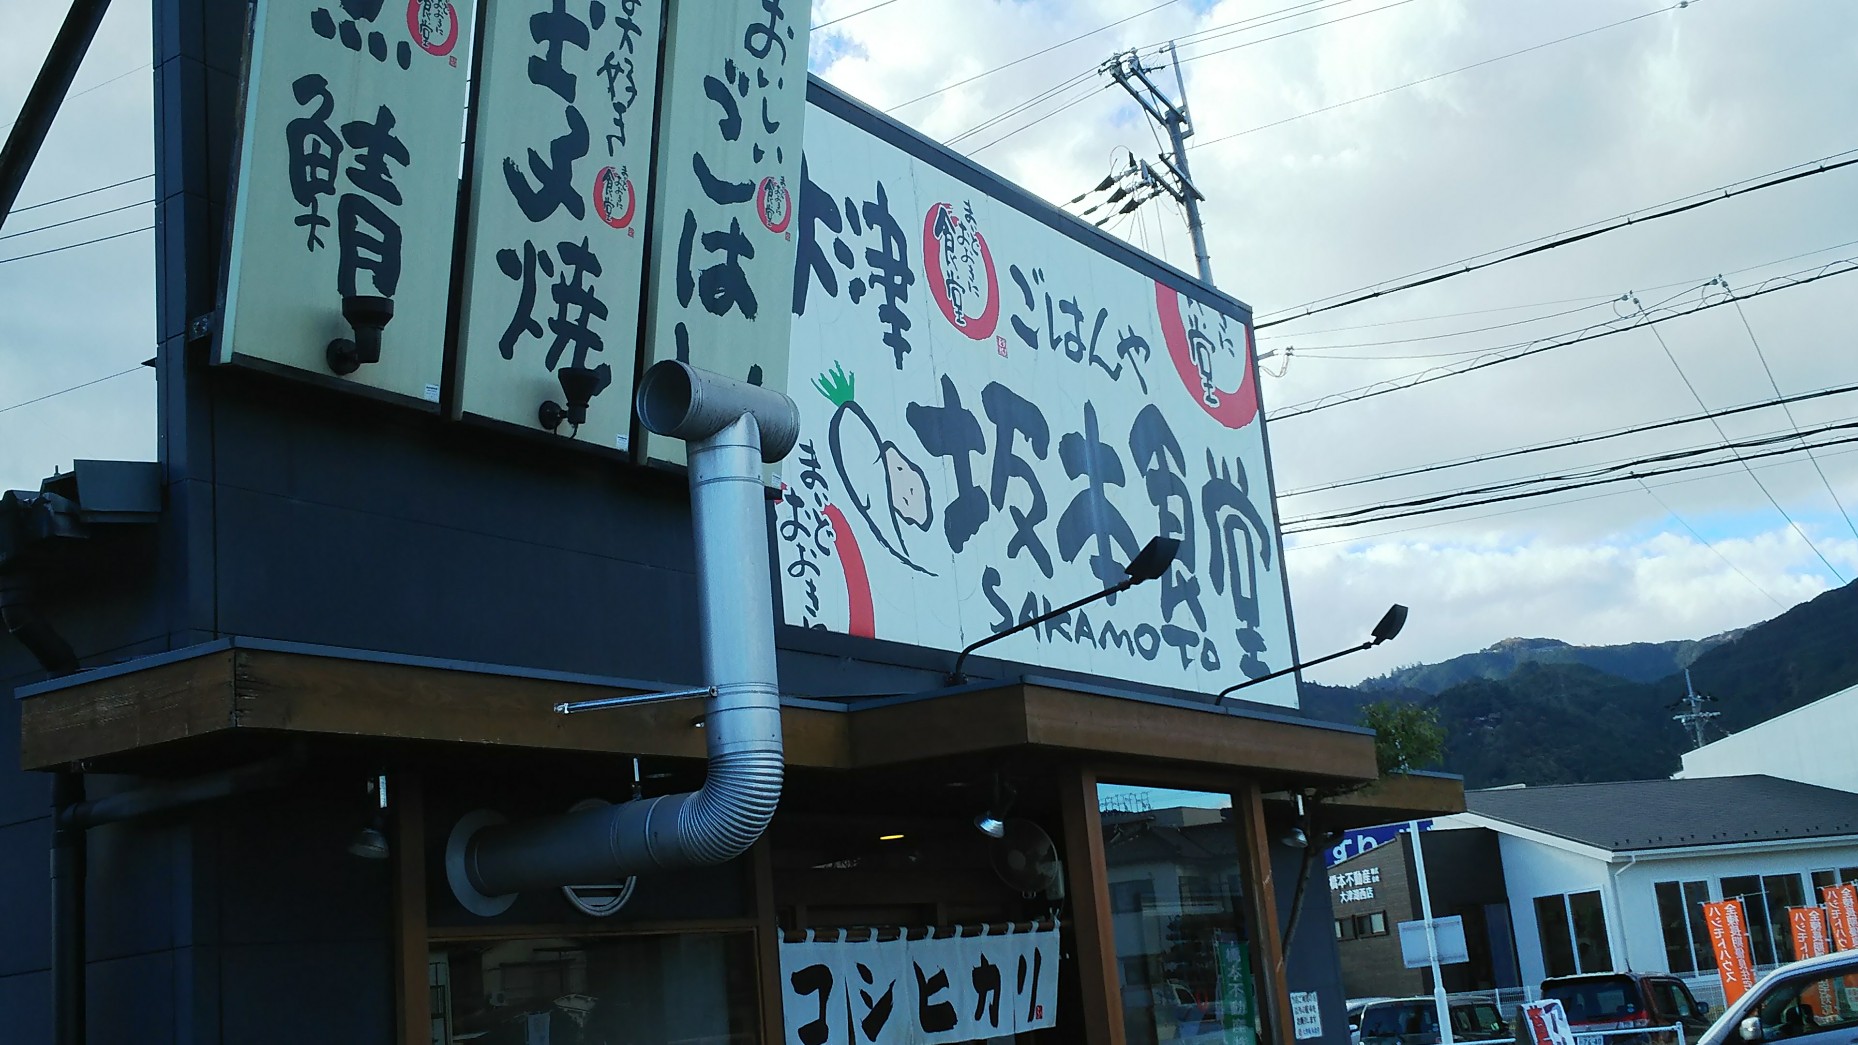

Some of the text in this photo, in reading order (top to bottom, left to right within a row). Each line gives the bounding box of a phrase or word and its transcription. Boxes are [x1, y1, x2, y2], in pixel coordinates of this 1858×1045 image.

[744, 0, 794, 164] おいしい
[934, 205, 966, 325] 食堂
[957, 221, 980, 298] おおきに
[964, 199, 979, 256] まいど
[1010, 264, 1151, 395] ごはんや
[1187, 296, 1218, 404] 堂
[799, 439, 831, 556] まいど
[906, 373, 1272, 679] 坂本食堂
[982, 565, 1221, 672] SAKAMOTO
[791, 947, 1041, 1045] コシヒカリ
